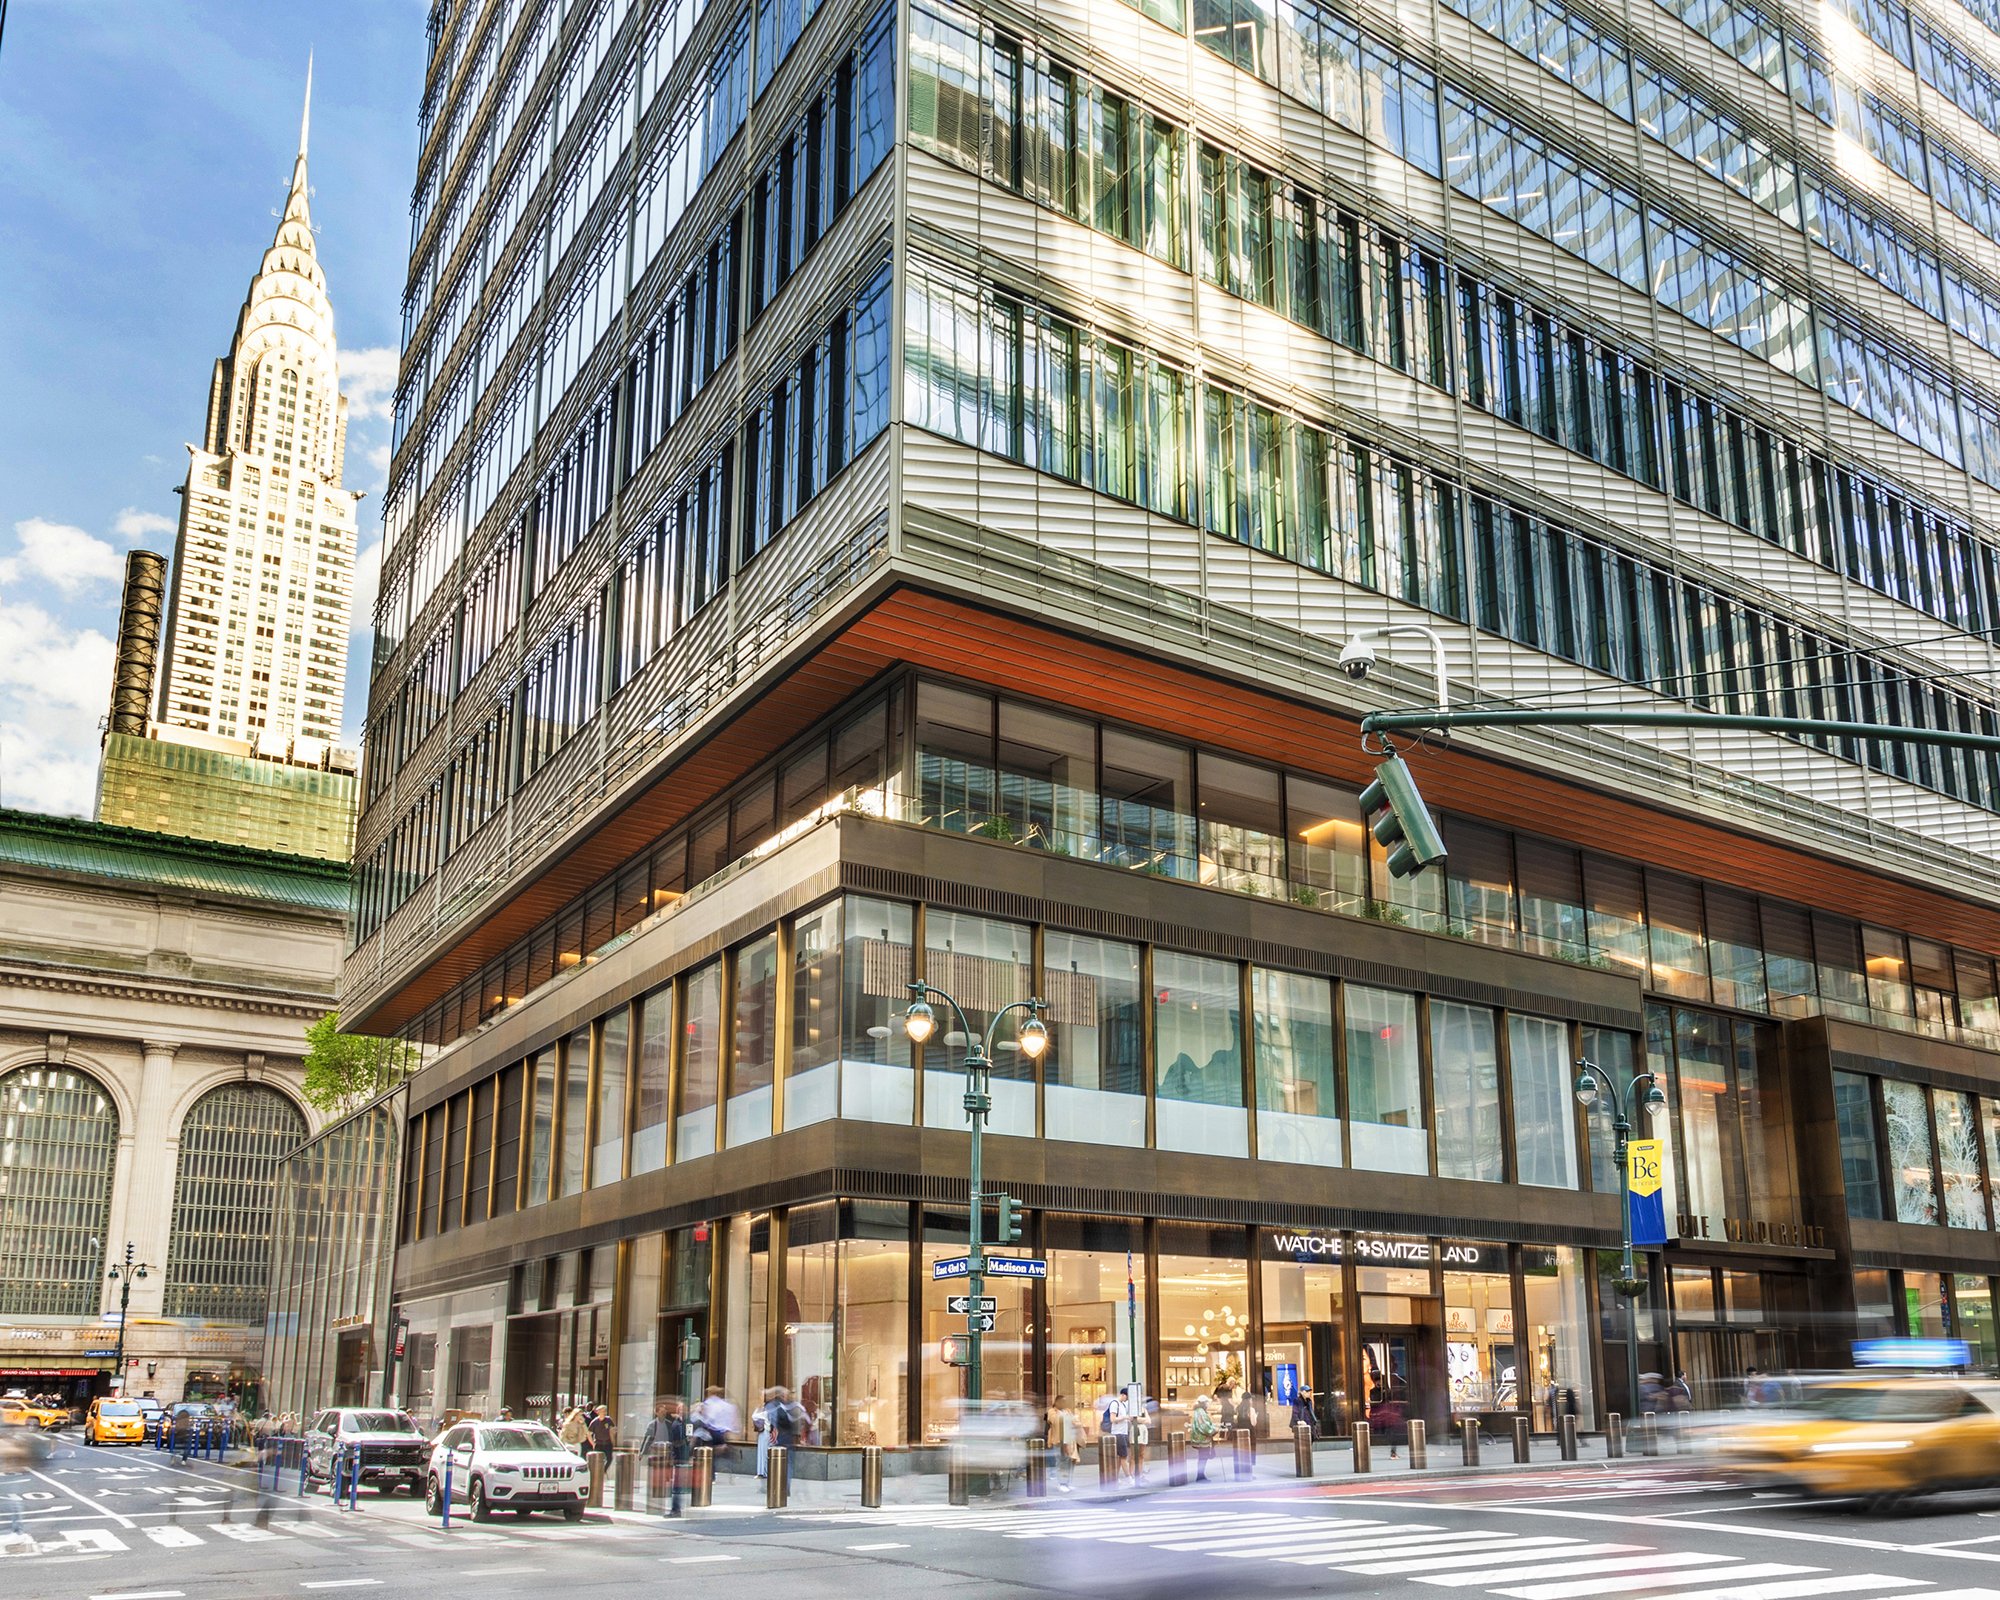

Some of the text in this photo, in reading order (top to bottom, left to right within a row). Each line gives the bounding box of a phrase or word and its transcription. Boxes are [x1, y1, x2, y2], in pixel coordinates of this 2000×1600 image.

[1632, 1156, 1658, 1179] Be
[1273, 1234, 1357, 1255] WATCHE
[1371, 1240, 1479, 1263] SWITZEAND
[935, 1261, 966, 1276] East 43rd St
[989, 1260, 1046, 1275] Madison Ave
[95, 1485, 232, 1498] ONLY
